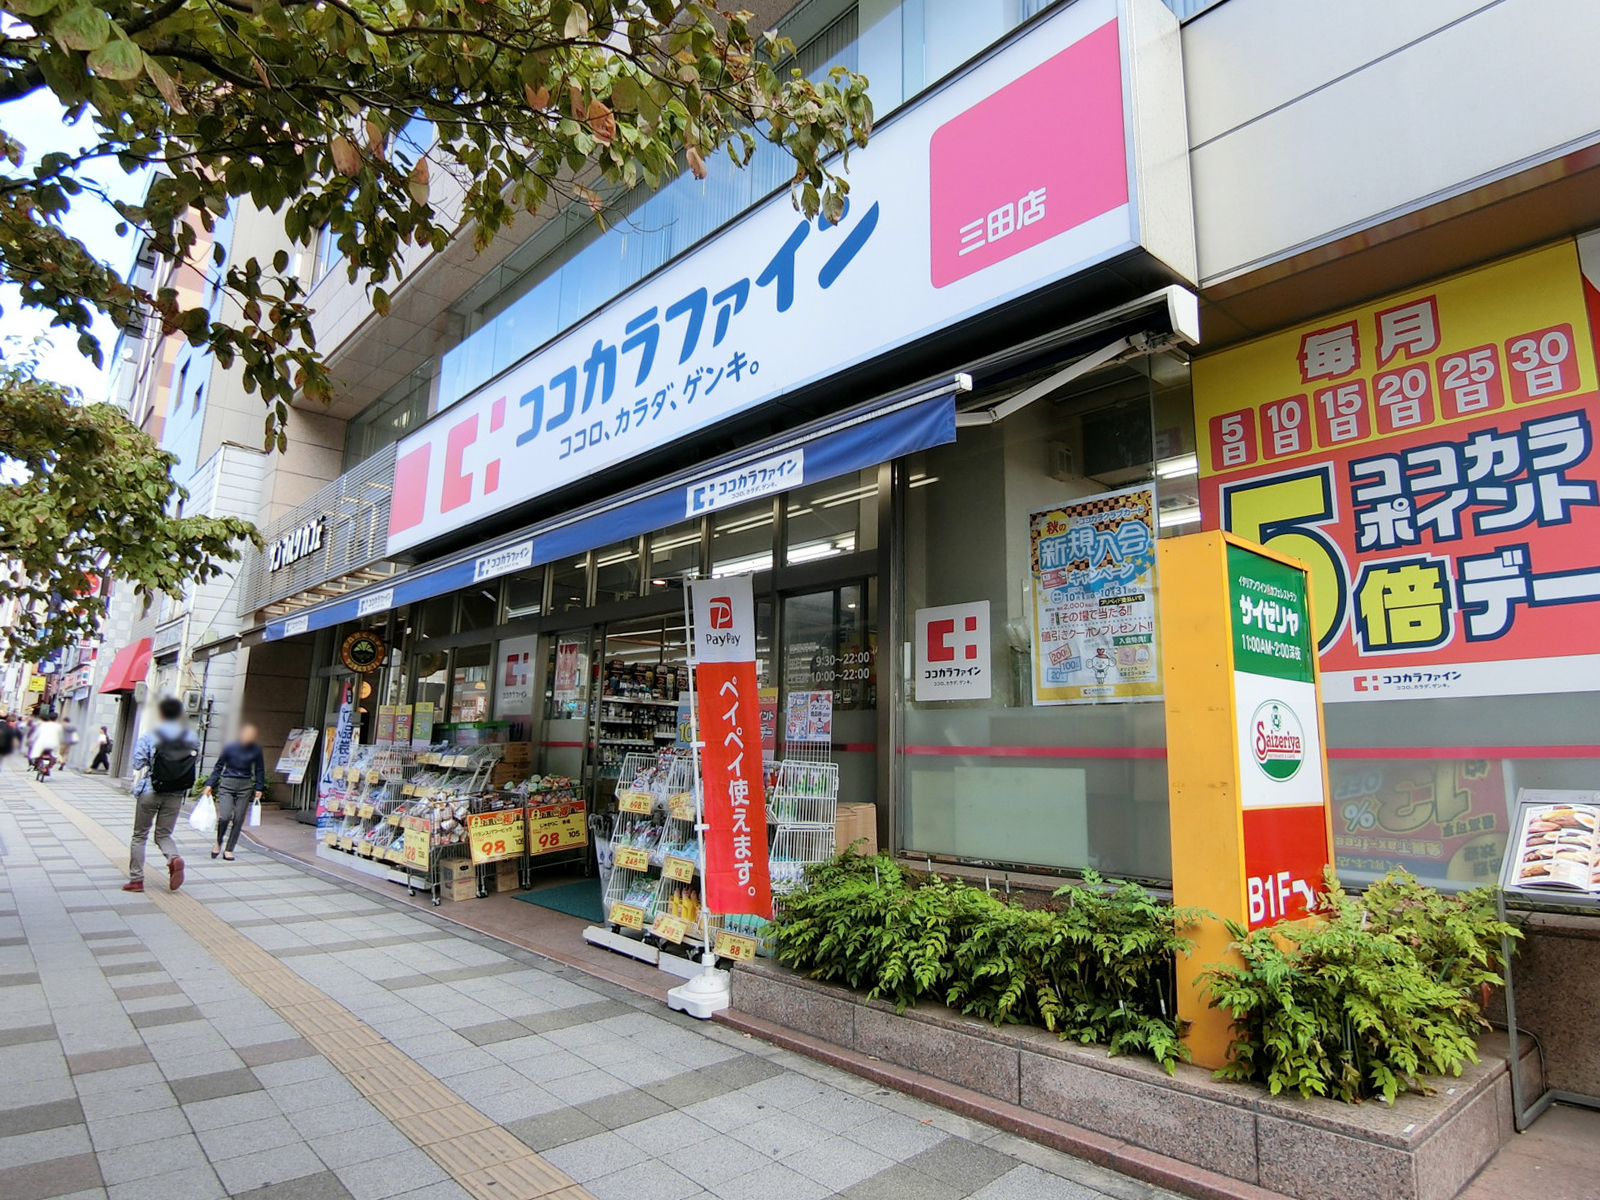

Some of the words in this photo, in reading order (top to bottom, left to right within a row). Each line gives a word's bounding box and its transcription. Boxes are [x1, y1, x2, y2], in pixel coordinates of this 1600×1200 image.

[958, 187, 1047, 256] 三田店
[515, 200, 880, 447] ココカラファイン
[1298, 296, 1439, 382] 毎月
[559, 351, 760, 460] ココロ、カラダ、ゲンキ。
[718, 460, 797, 496] ココカラファイン
[1352, 414, 1585, 503] ココカラ
[1360, 473, 1591, 549] ポイント
[1041, 522, 1147, 567] 新規入会
[1069, 563, 1134, 585] キャンペーン
[1240, 594, 1299, 637] サイゼリヤ
[705, 632, 741, 647] PayPay
[925, 666, 981, 679] ココカラファイン
[1383, 671, 1461, 684] ココカラファイン
[1256, 721, 1301, 755] Saizeriya
[719, 676, 756, 896] ペイペイ使えます。
[482, 840, 506, 855] 98
[538, 832, 560, 848] 98
[568, 830, 580, 838] 105
[1247, 870, 1292, 924] B1F
[730, 944, 741, 956] 88
